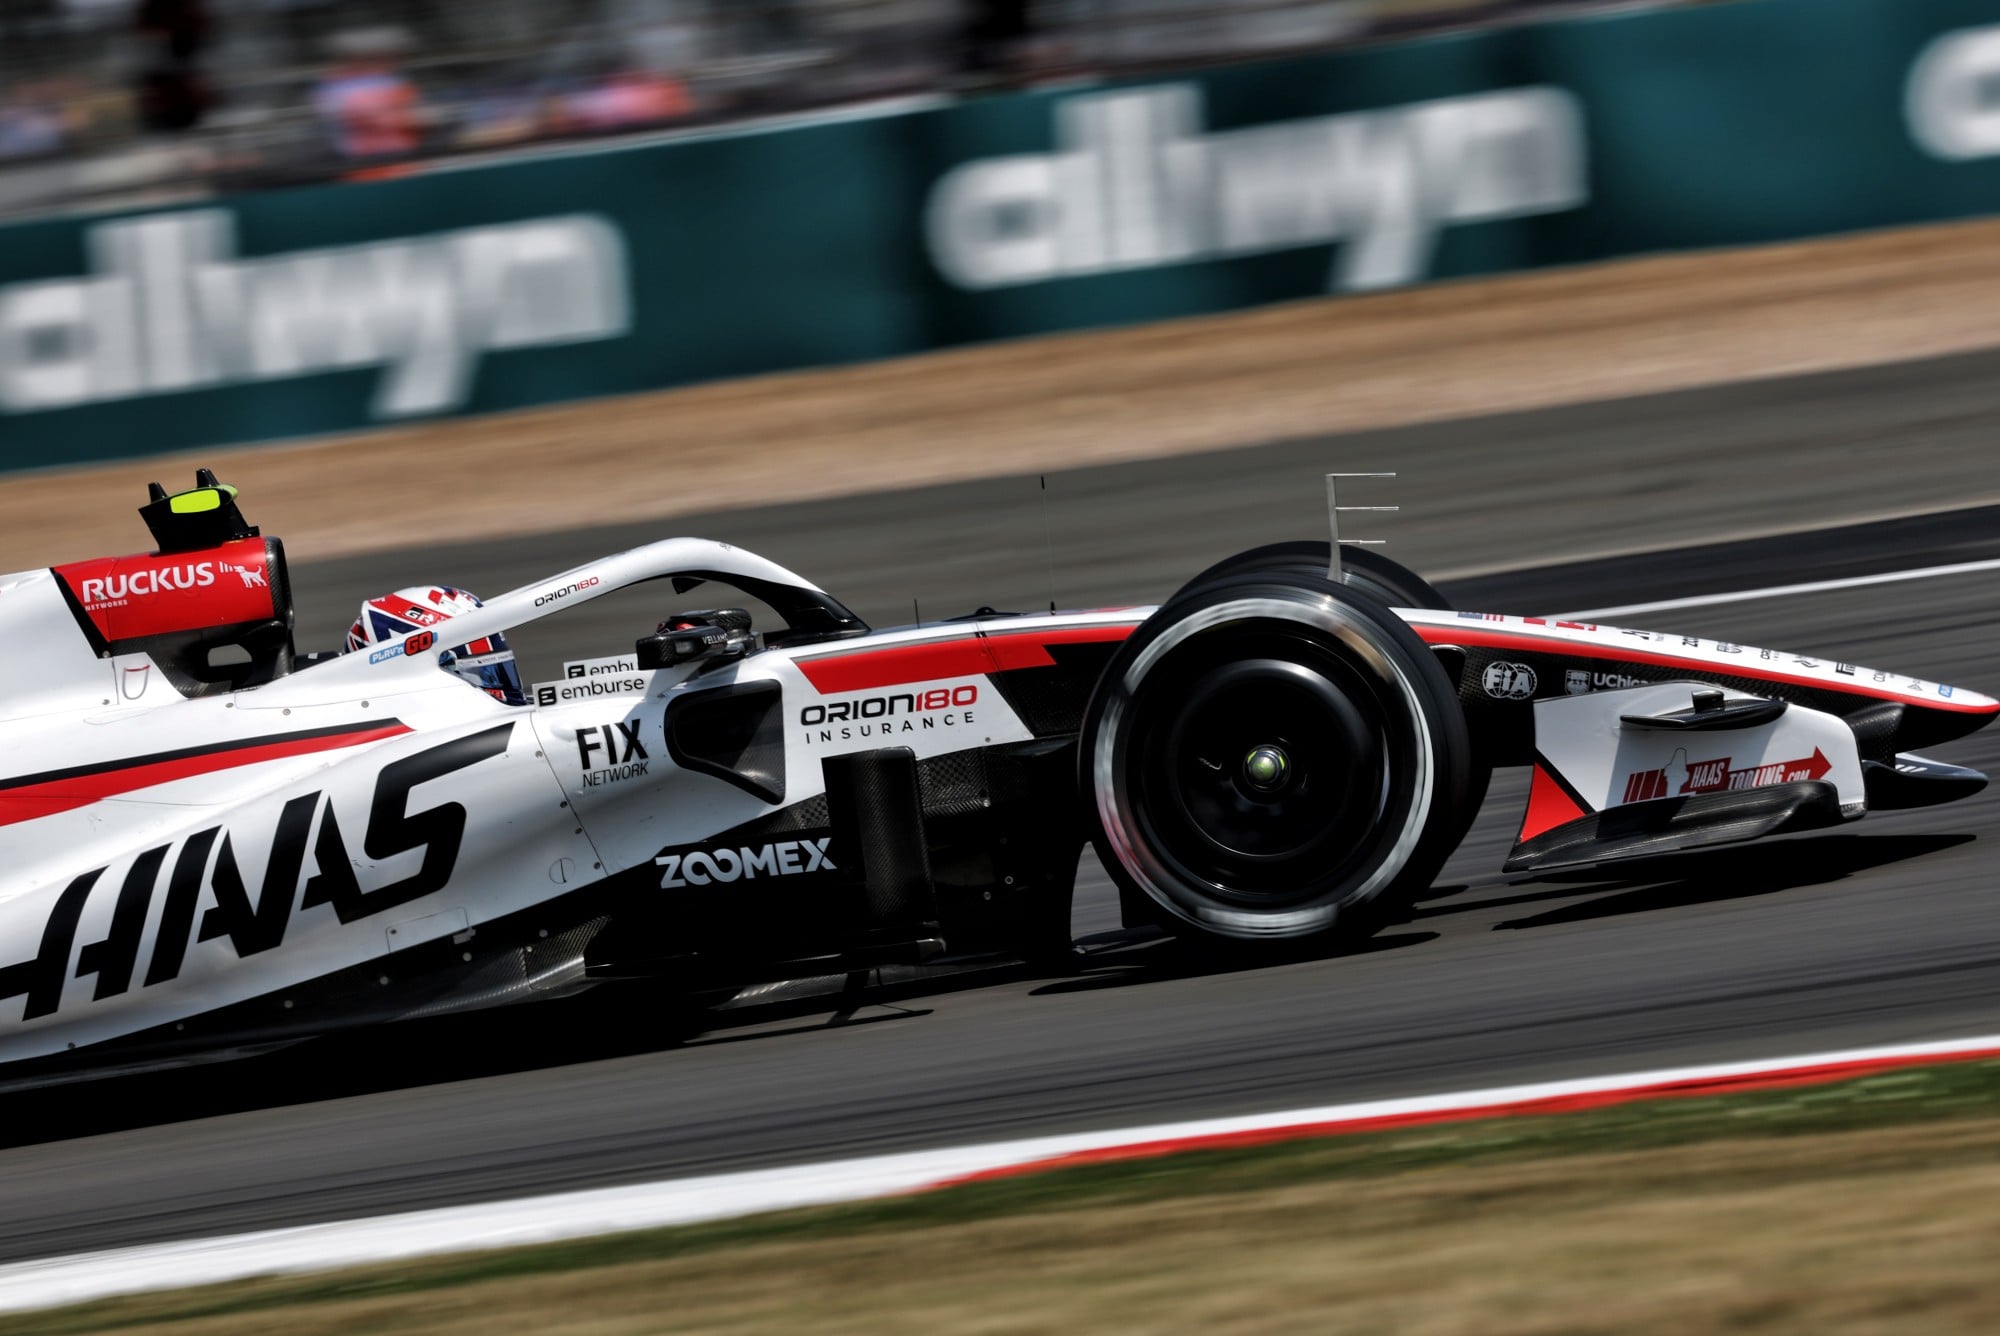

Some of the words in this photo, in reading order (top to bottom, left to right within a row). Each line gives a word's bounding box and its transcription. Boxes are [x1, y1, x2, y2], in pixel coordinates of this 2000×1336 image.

[82, 562, 215, 603] RUCKUS
[534, 576, 599, 607] ORION180
[85, 599, 128, 611] NETWORKS
[405, 632, 432, 656] GO
[561, 678, 645, 700] emburse
[800, 684, 977, 727] ORION180
[805, 711, 975, 744] INSURANCE
[575, 719, 649, 770] FIX
[582, 760, 649, 788] NETWORK
[1690, 761, 1726, 788] HAAS
[0, 721, 516, 1021] HAAS
[655, 837, 839, 889] ZOOMEX
